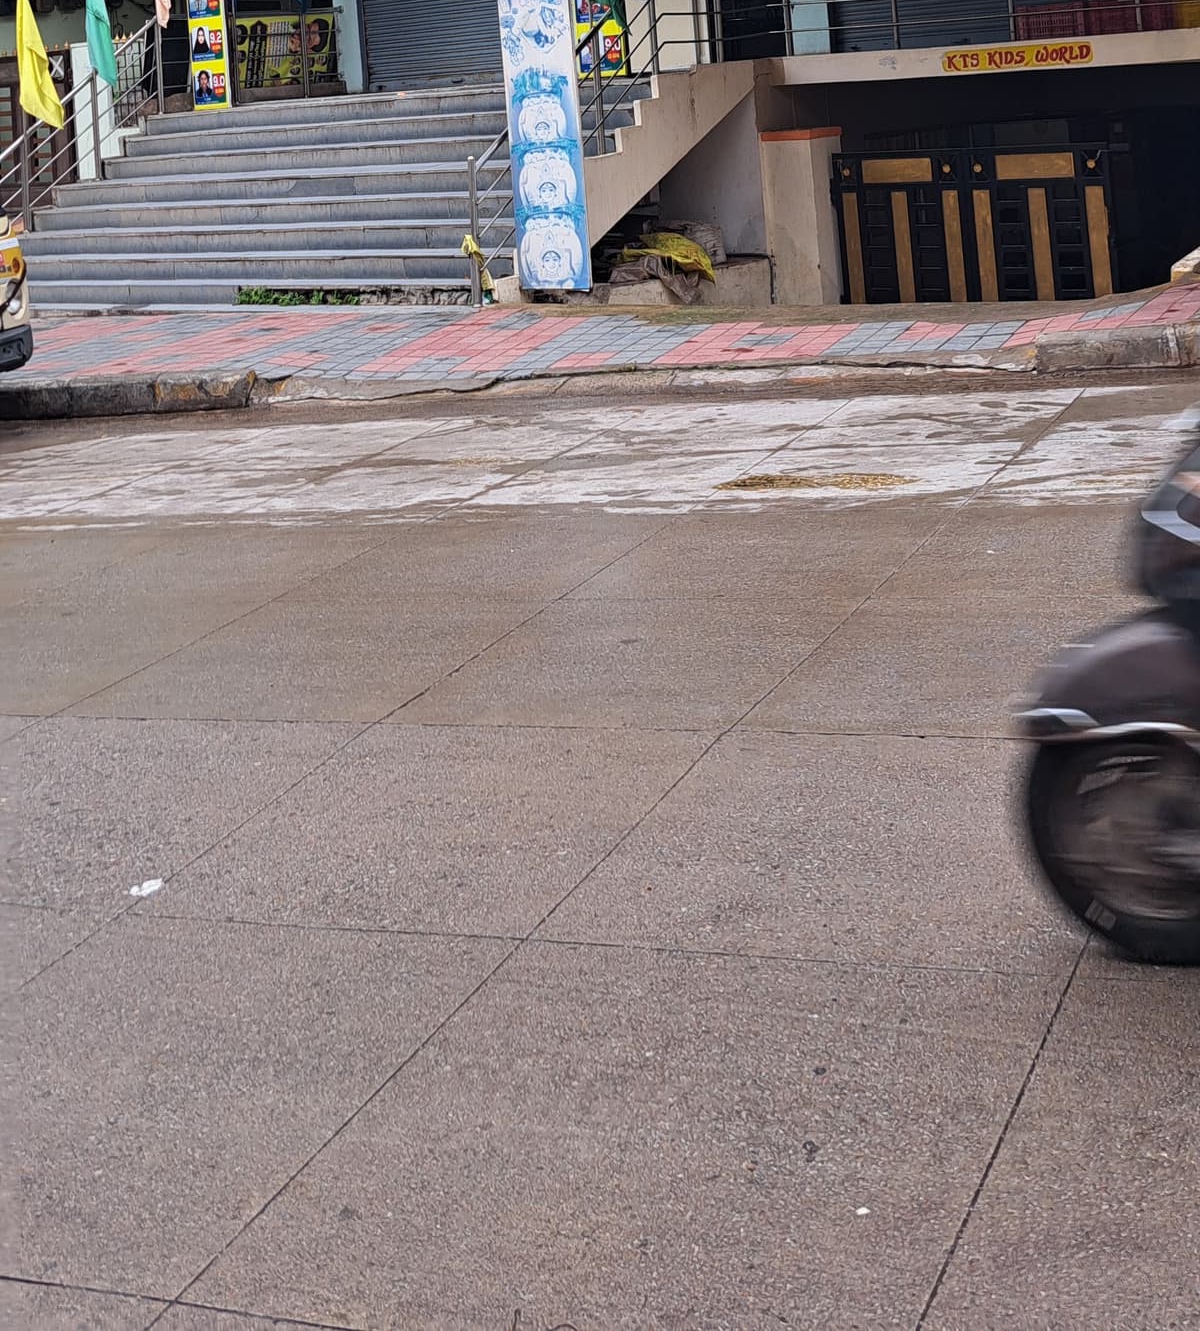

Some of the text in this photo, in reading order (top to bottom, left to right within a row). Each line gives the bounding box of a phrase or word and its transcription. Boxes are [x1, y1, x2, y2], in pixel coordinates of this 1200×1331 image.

[210, 32, 222, 44] 9.2
[946, 44, 1091, 71] KTS KIDS WORLD
